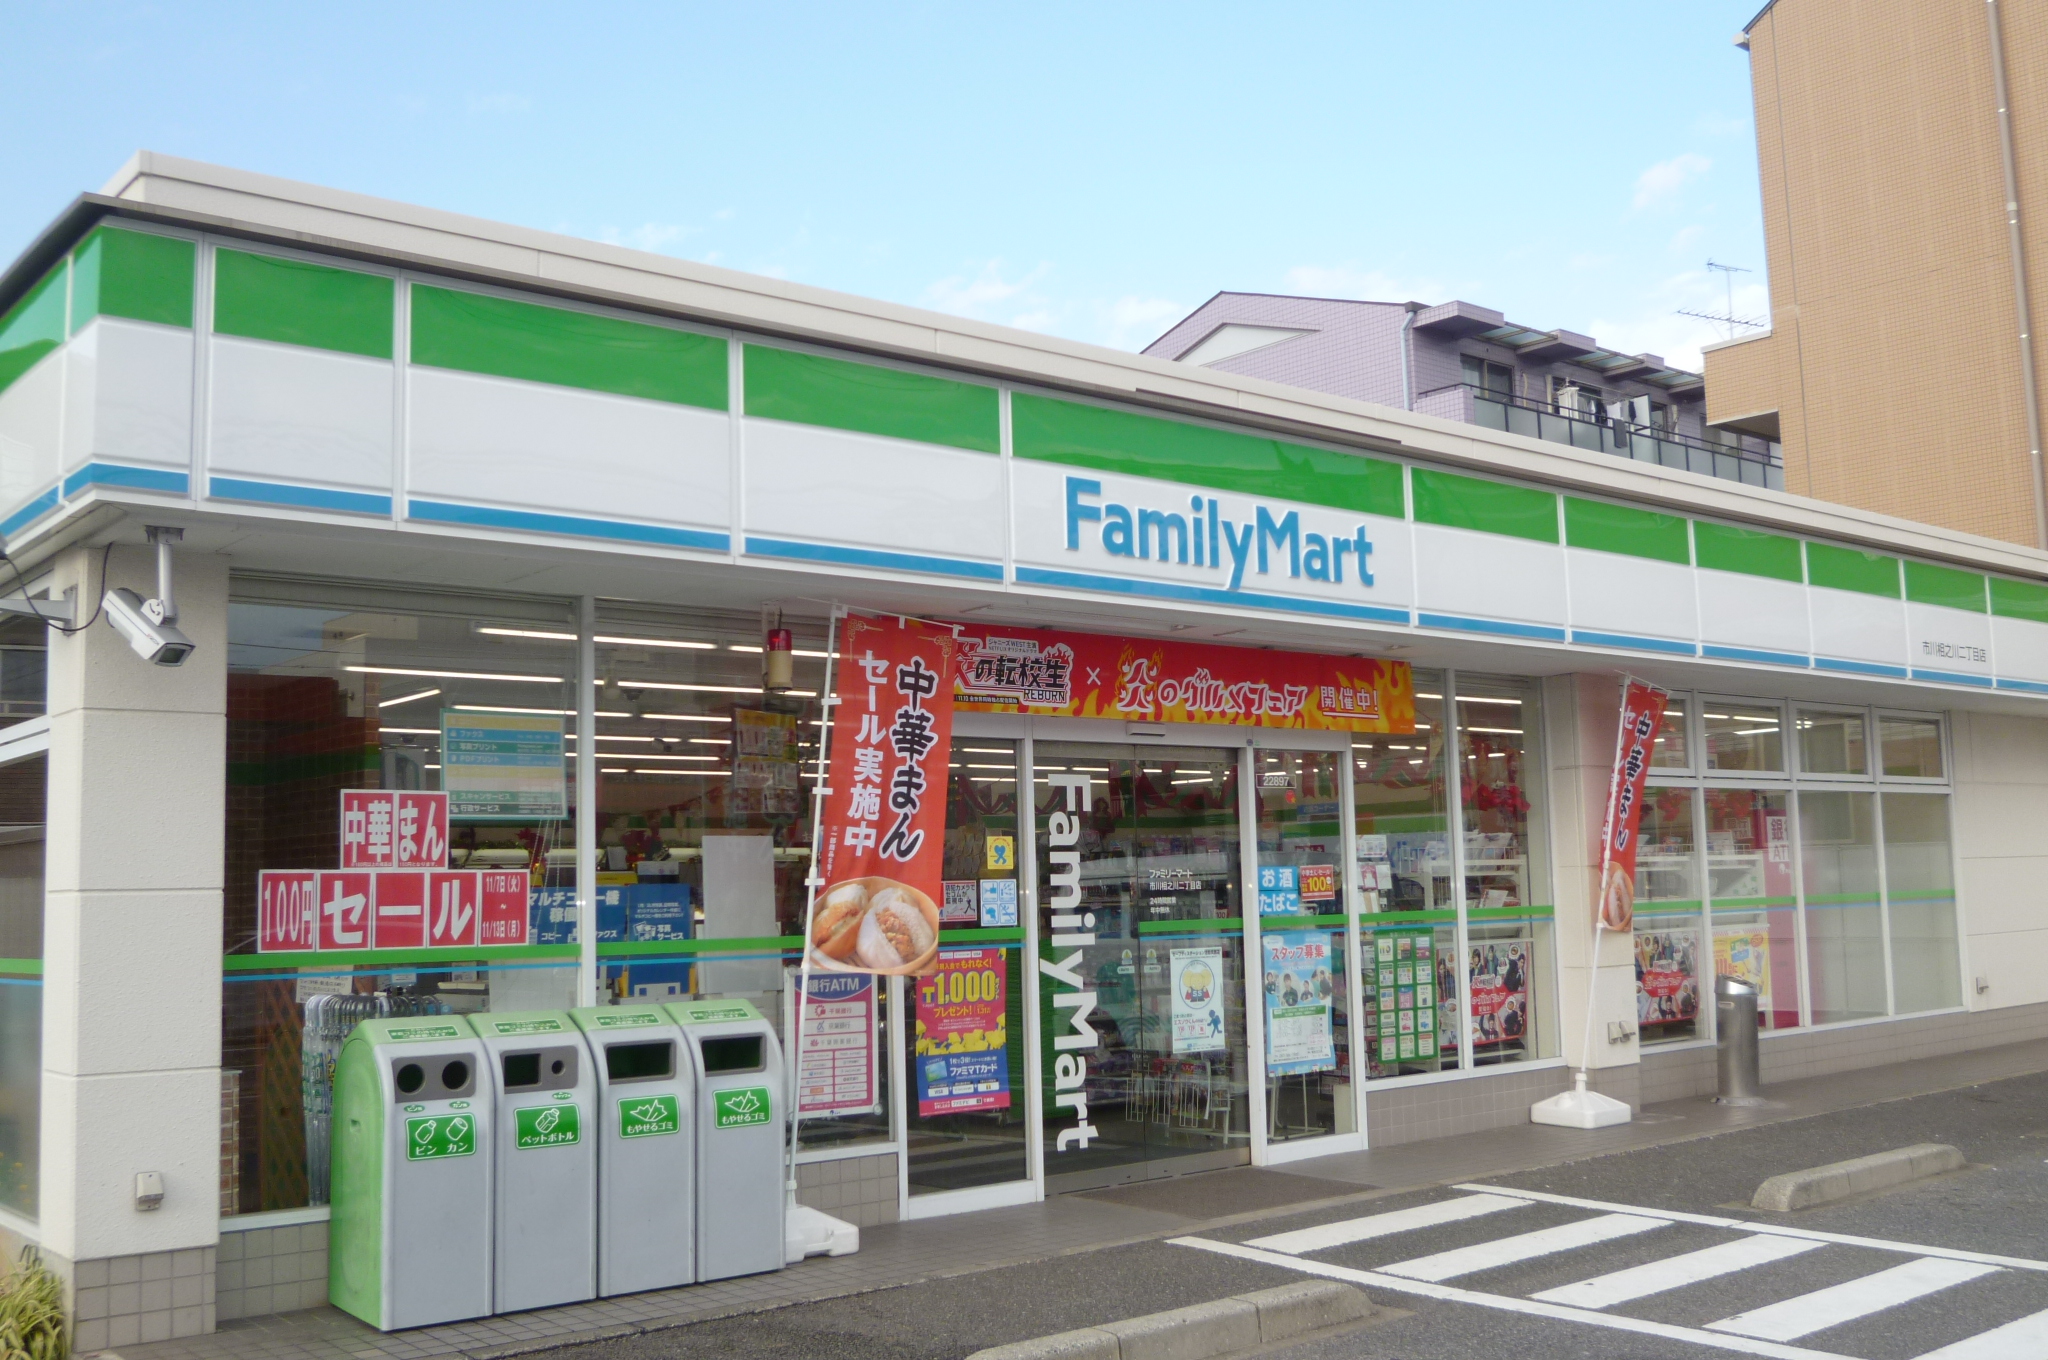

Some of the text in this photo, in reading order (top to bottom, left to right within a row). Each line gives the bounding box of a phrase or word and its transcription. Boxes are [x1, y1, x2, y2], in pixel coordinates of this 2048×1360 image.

[1065, 475, 1375, 590] FamilyMart
[1922, 641, 1987, 662] 市川相之川二丁目店
[1116, 654, 1308, 716] 炎のグルメフェア
[1320, 685, 1380, 713] 開催中!
[1024, 689, 1066, 703] REBORN
[844, 650, 890, 857] セール実施中
[880, 656, 937, 861] 中華まん
[1263, 776, 1290, 787] 22897
[344, 800, 444, 863] 中華まん
[1773, 844, 1789, 862] AT
[1149, 868, 1194, 879] ファミリーマート
[1262, 868, 1293, 888] お酒
[1149, 880, 1202, 891] 市川相之川二丁目店
[529, 891, 620, 906] マルチコー機
[1259, 893, 1298, 913] たばこ
[541, 932, 562, 941] コピー
[596, 930, 618, 939] ァクス
[657, 932, 684, 941] サービス
[1271, 944, 1325, 961] スタッフ募集
[1040, 773, 1099, 1152] FamilyMart
[808, 977, 860, 993] 銀行ATM
[934, 969, 996, 1005] 1,000
[934, 1004, 972, 1018] プレゼント!
[949, 1063, 998, 1077] ファミマTカード
[721, 1112, 766, 1125] もやせるゴミ
[626, 1120, 674, 1134] もやせるゴミ
[521, 1133, 575, 1145] ペットボトル
[415, 1142, 468, 1156] ビン カン
